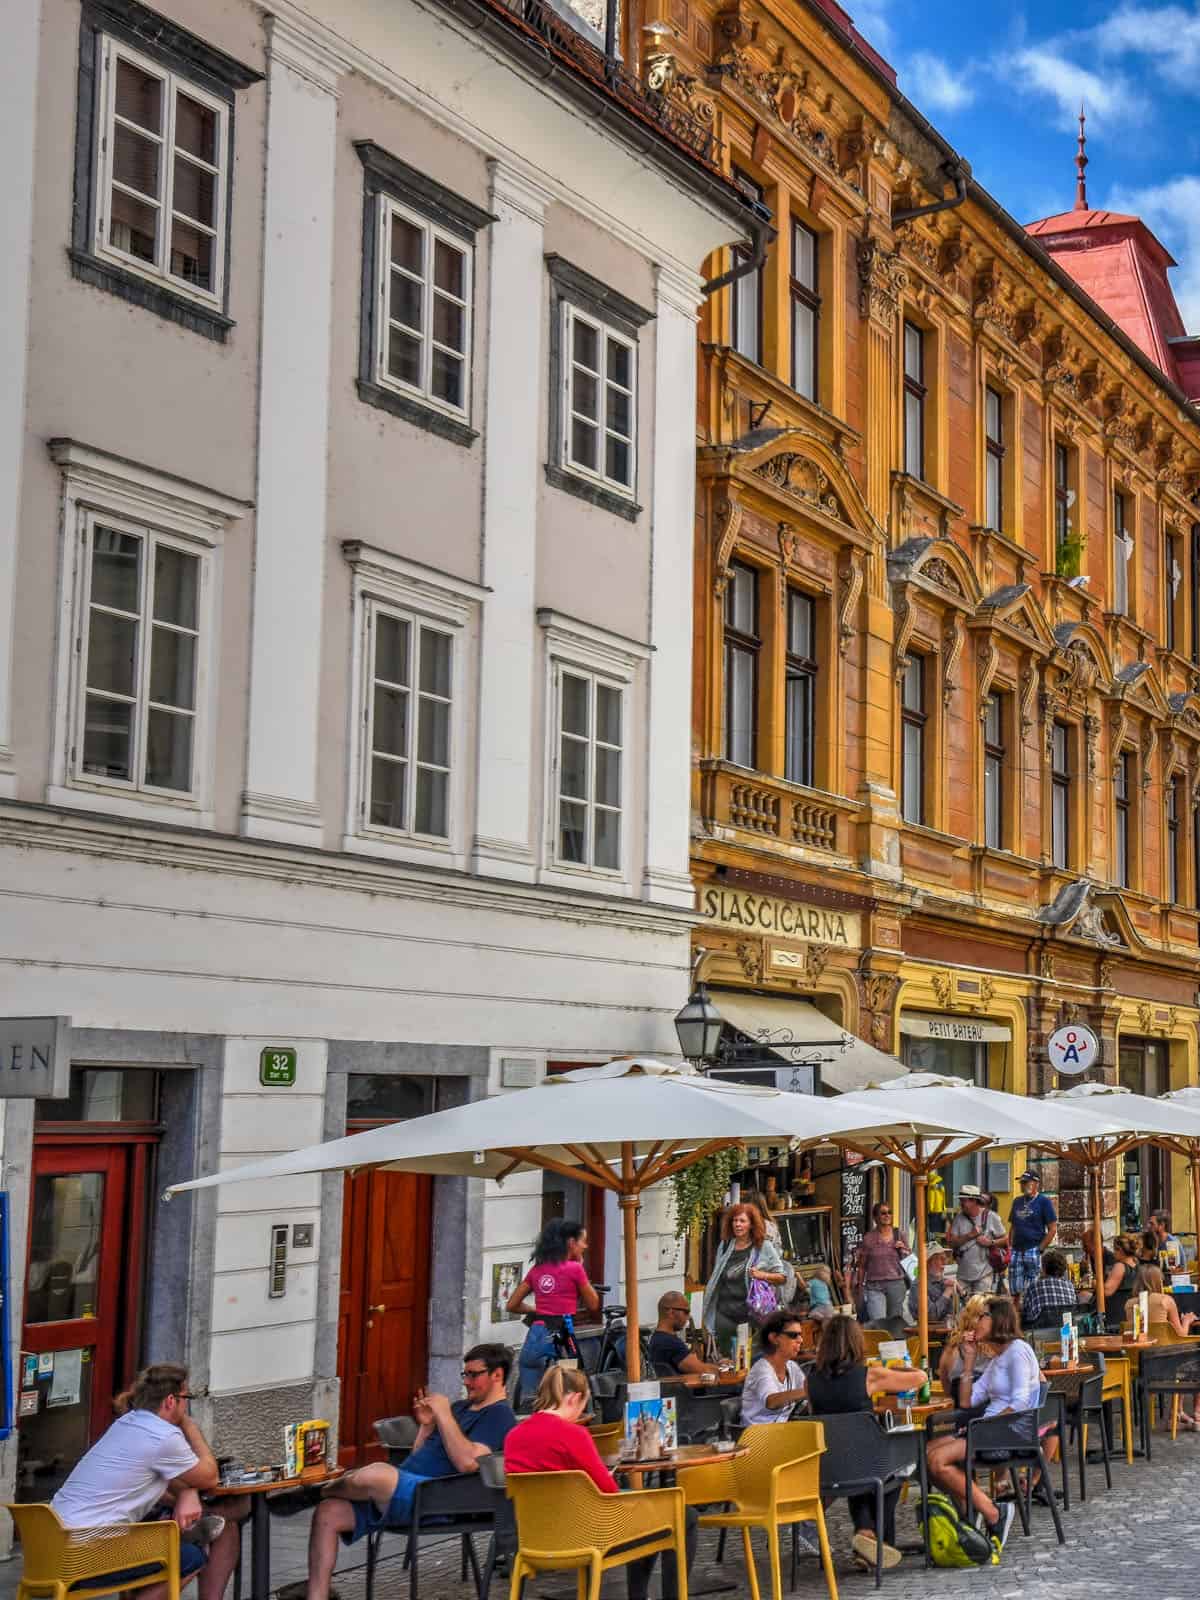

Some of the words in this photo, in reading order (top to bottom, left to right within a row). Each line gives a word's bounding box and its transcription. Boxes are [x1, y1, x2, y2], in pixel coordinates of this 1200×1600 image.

[928, 1021, 951, 1037] PETIT
[0, 1046, 50, 1070] EN
[272, 1054, 289, 1070] 32
